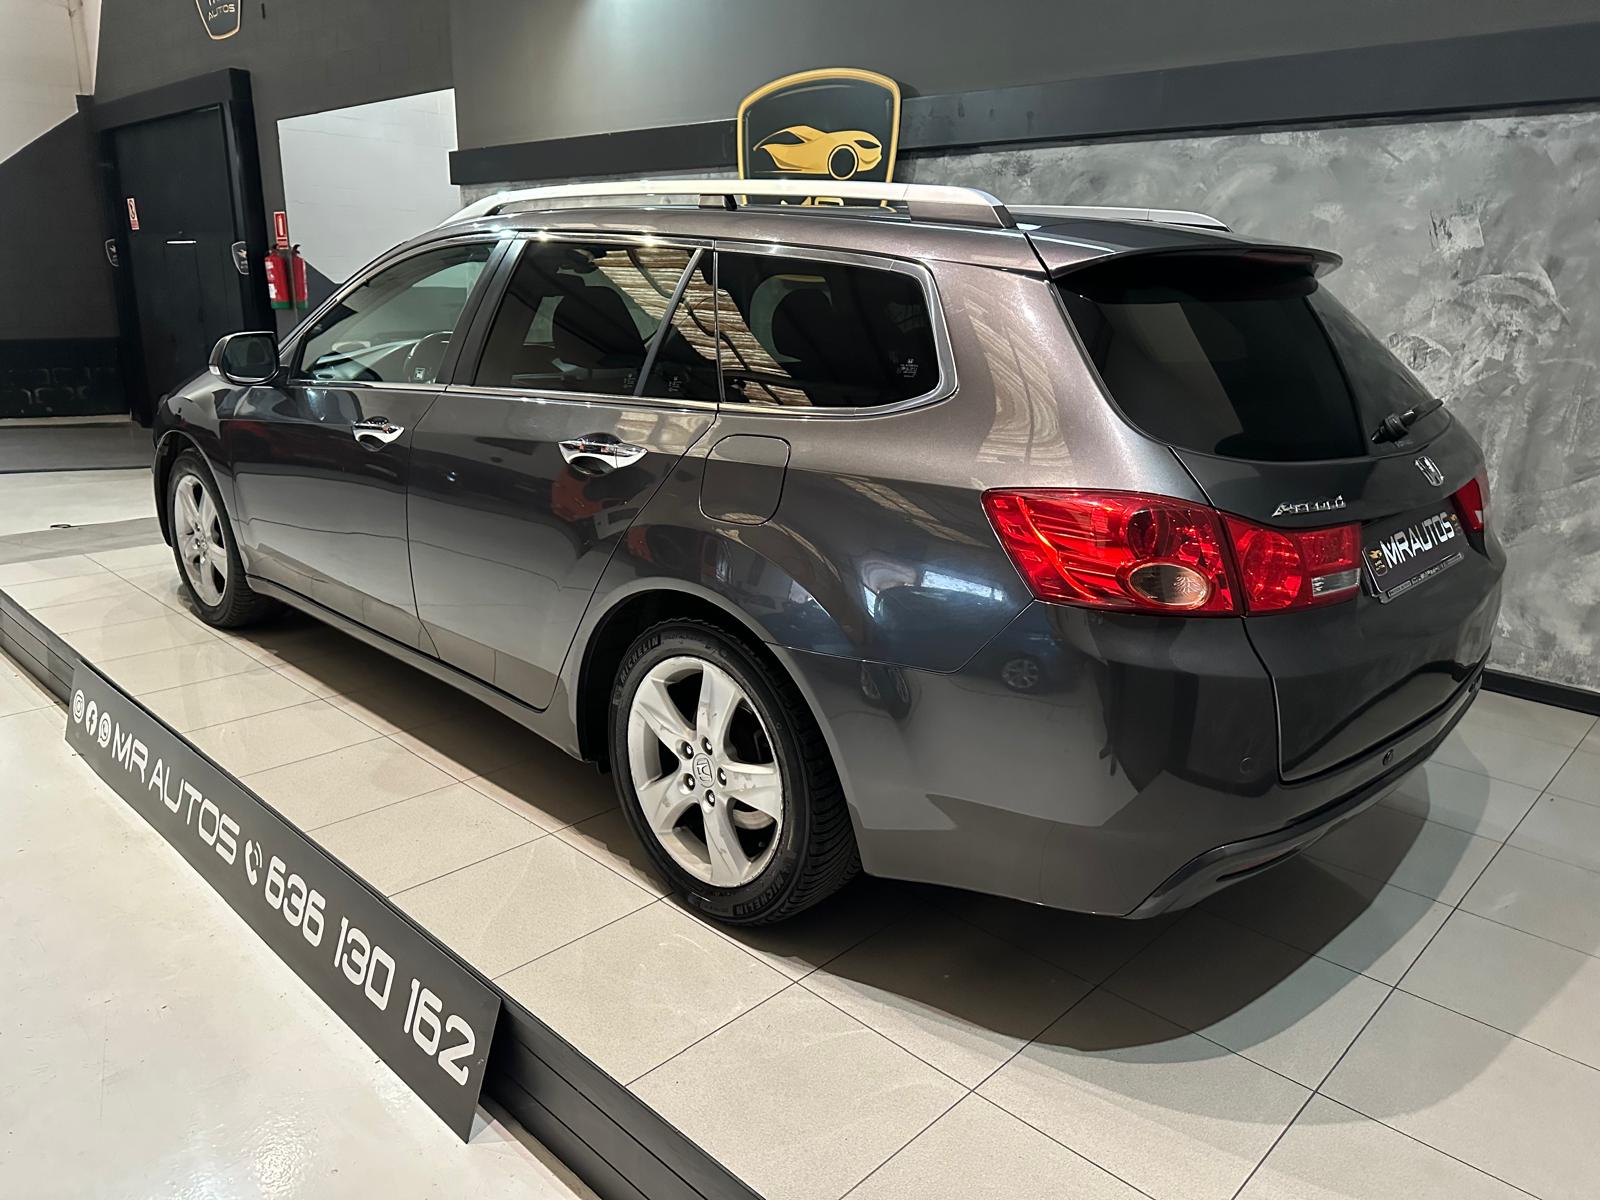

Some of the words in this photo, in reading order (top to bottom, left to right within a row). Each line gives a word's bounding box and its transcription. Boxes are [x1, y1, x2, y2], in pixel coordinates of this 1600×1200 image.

[620, 635, 660, 685] MICHELIN
[112, 723, 149, 783] MR
[148, 759, 240, 865] AUTOS
[265, 856, 326, 947] 636
[334, 916, 396, 1010] 130
[404, 978, 476, 1086] 162
[735, 873, 785, 915] MICHELIN
